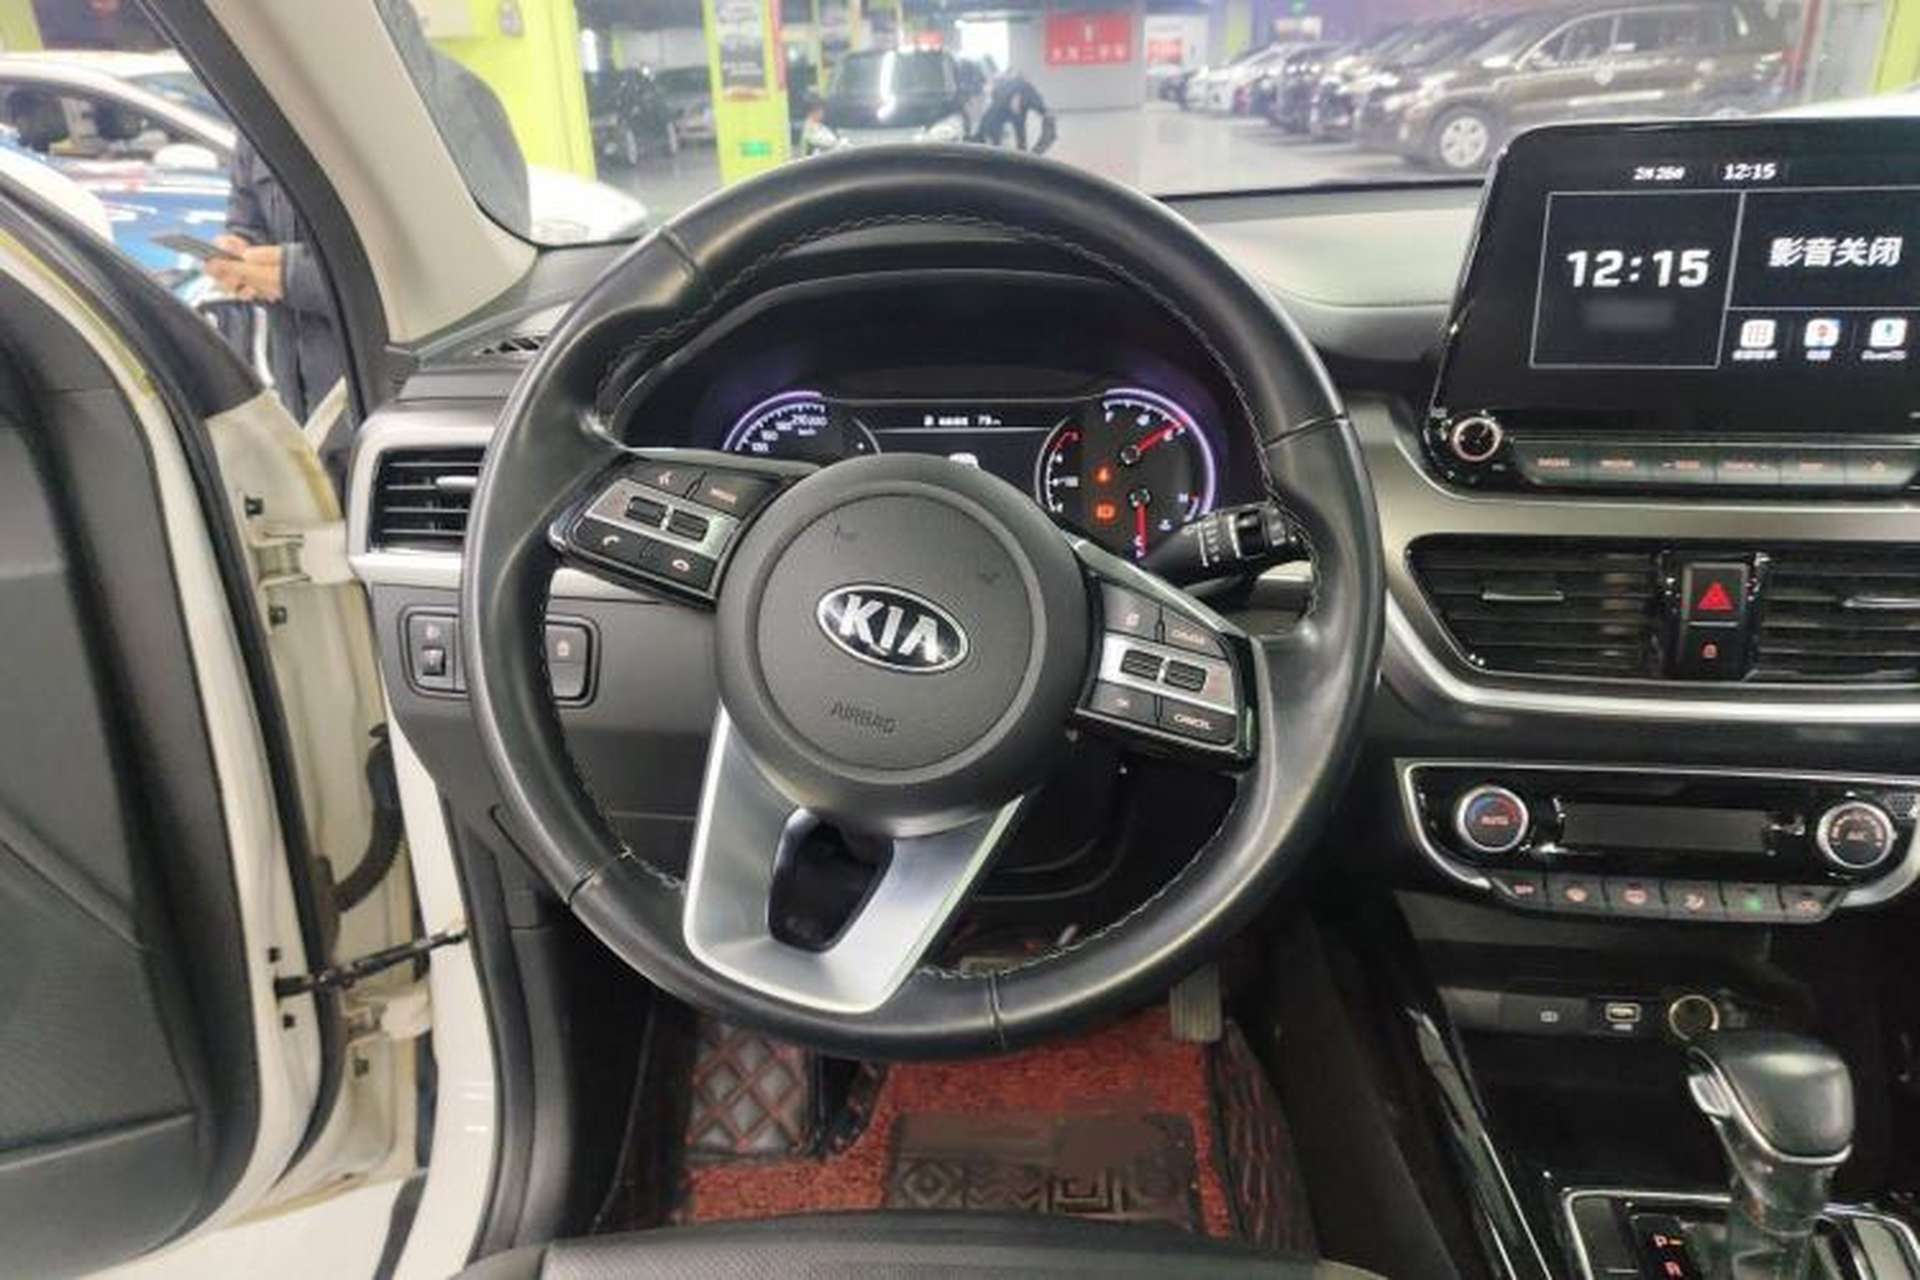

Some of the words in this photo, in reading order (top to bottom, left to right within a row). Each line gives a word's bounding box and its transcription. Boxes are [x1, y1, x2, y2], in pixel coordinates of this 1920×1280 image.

[1723, 163, 1776, 180] 12:15
[1566, 250, 1710, 287] 12:15
[1768, 237, 1903, 267] 影音关闭
[839, 594, 938, 663] KIA
[829, 701, 897, 734] AIRBAG
